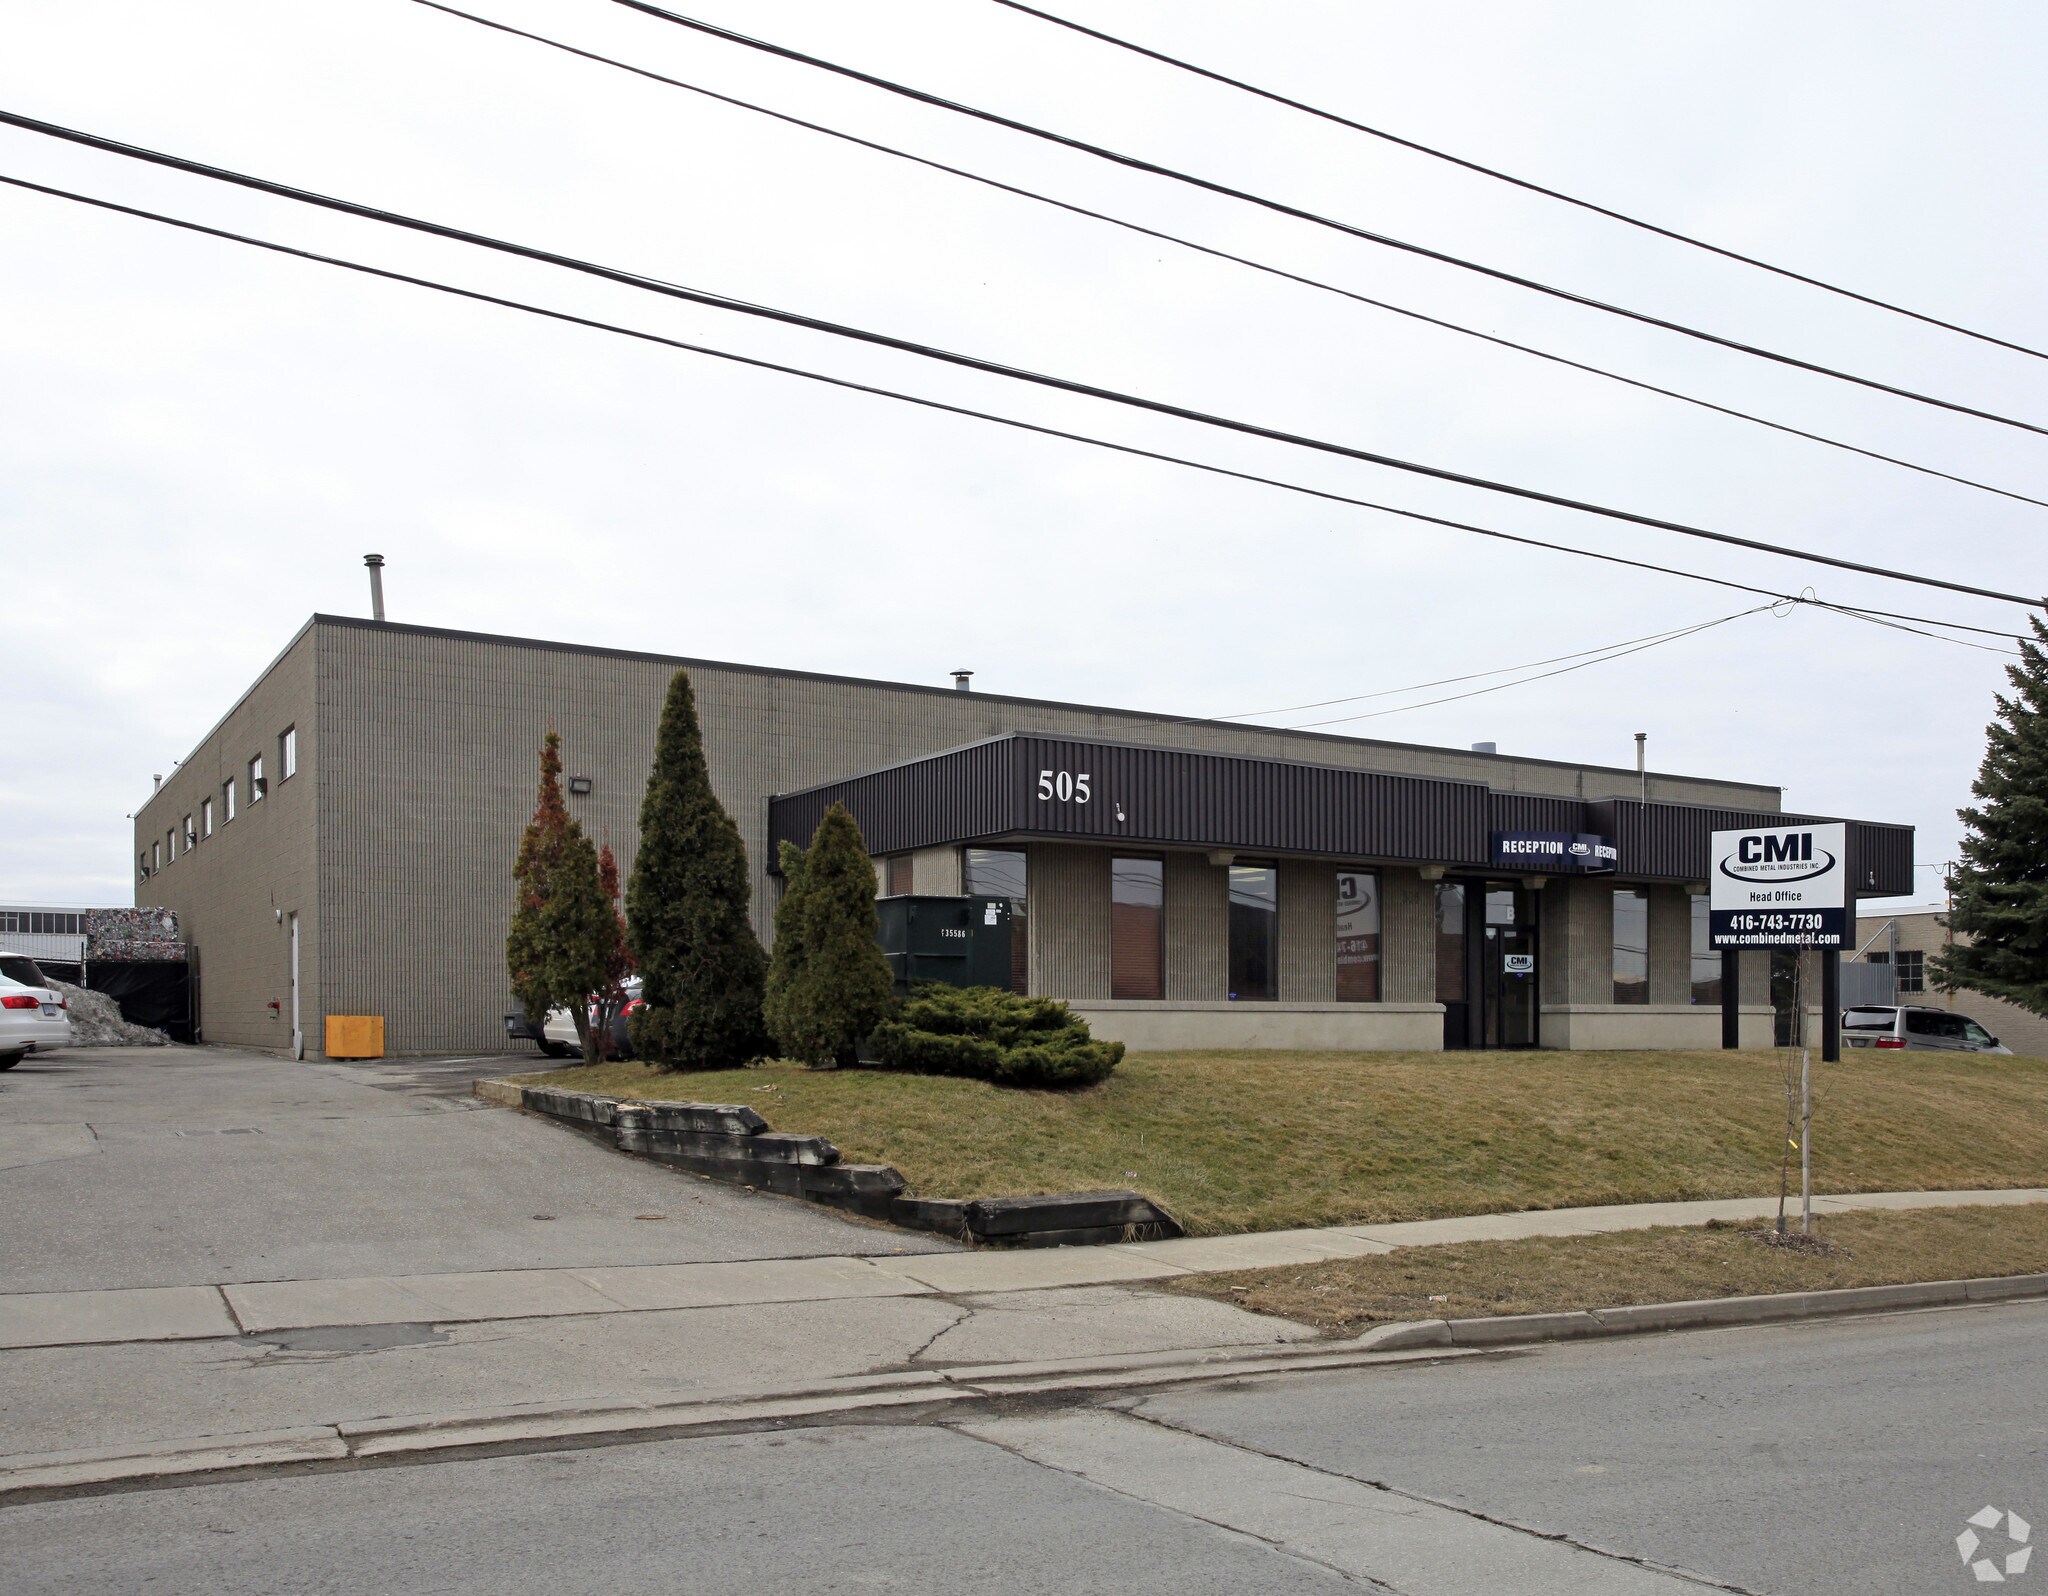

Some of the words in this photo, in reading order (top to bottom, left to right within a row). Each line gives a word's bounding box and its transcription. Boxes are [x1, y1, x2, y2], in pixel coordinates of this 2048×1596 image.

[1037, 770, 1091, 804] 505
[1502, 840, 1563, 855] RECEPTION
[1572, 843, 1587, 851] CMI
[1738, 832, 1813, 864] CMI
[1749, 891, 1772, 902] Head
[1774, 890, 1802, 902] Office
[1730, 914, 1823, 930] 416-743-7730
[1714, 932, 1840, 945] www.combinedmetal.com
[1510, 956, 1528, 965] CMI
